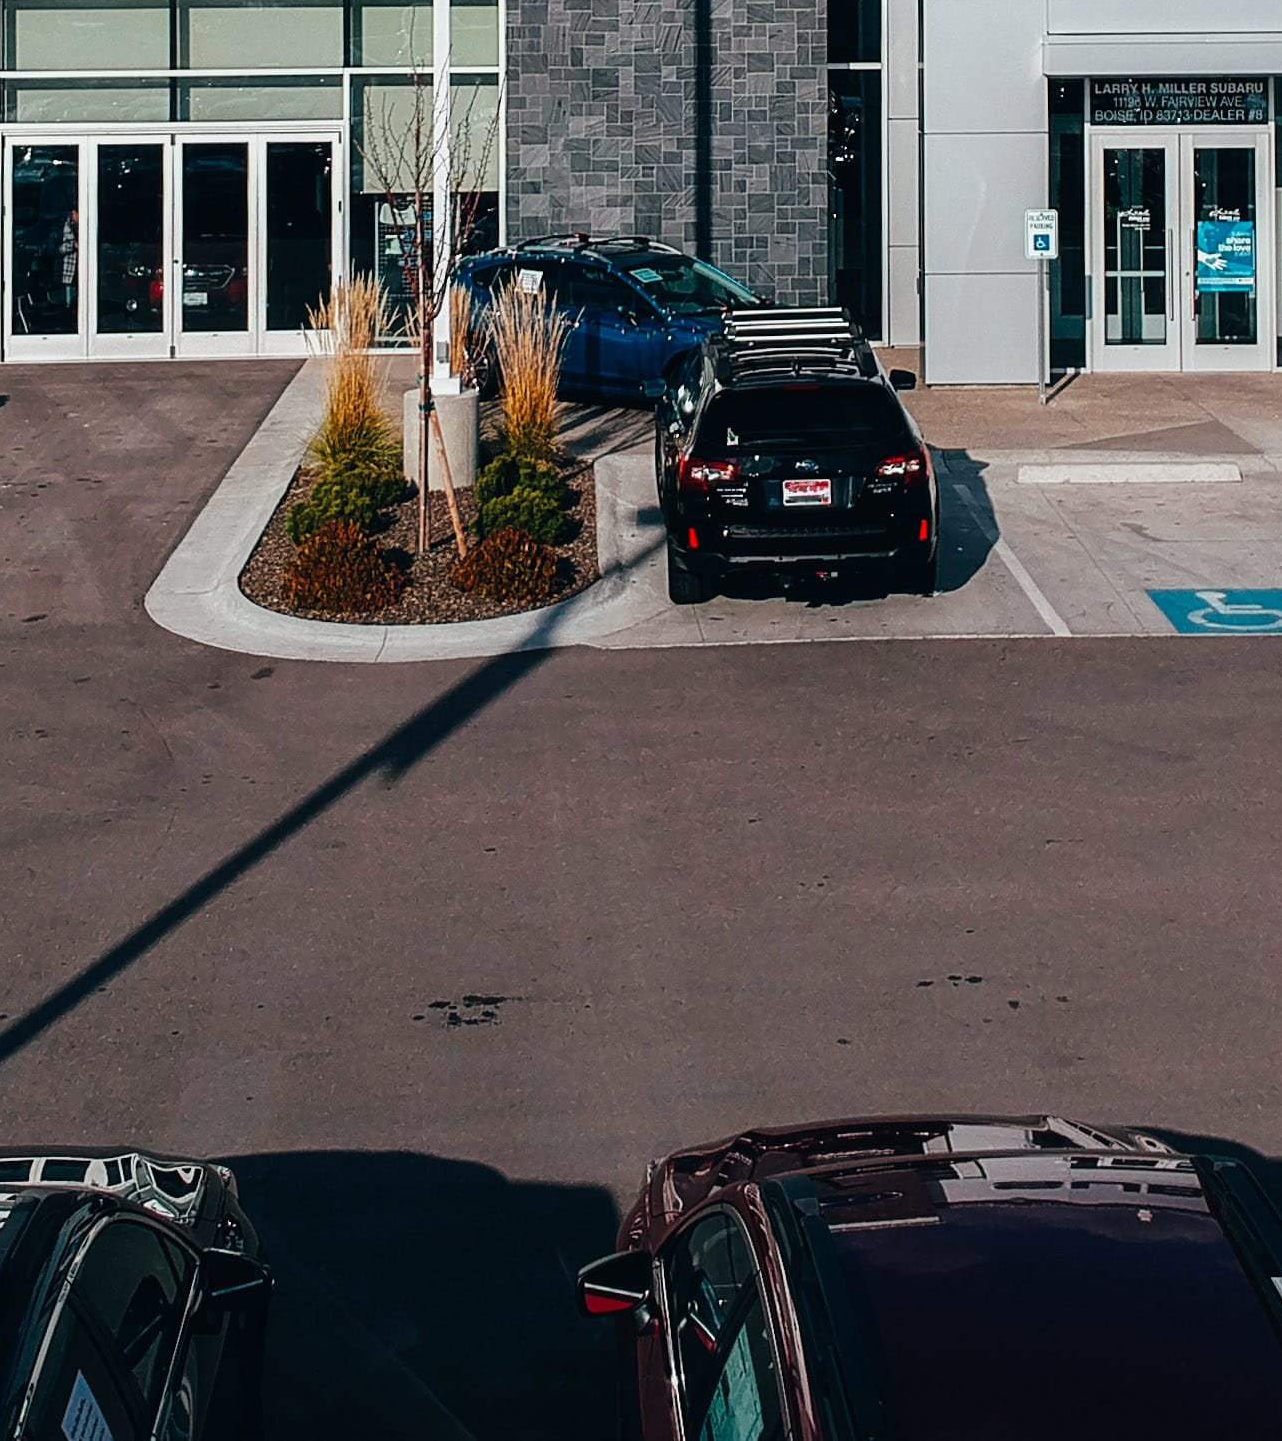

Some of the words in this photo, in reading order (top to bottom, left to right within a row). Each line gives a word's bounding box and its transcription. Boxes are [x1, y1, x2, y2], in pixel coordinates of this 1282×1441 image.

[1094, 83, 1139, 95] LARRY
[1142, 83, 1156, 94] H.
[1159, 83, 1207, 94] MILLER
[1209, 82, 1264, 94] SUBARU
[1113, 96, 1142, 108] 11196
[1144, 96, 1159, 107] W.
[1161, 96, 1217, 108] FAIRVIEW
[1219, 95, 1246, 107] AVE.
[1139, 110, 1153, 121] ID
[1225, 237, 1252, 245] share
[1217, 243, 1232, 252] the
[1233, 244, 1252, 252] love
